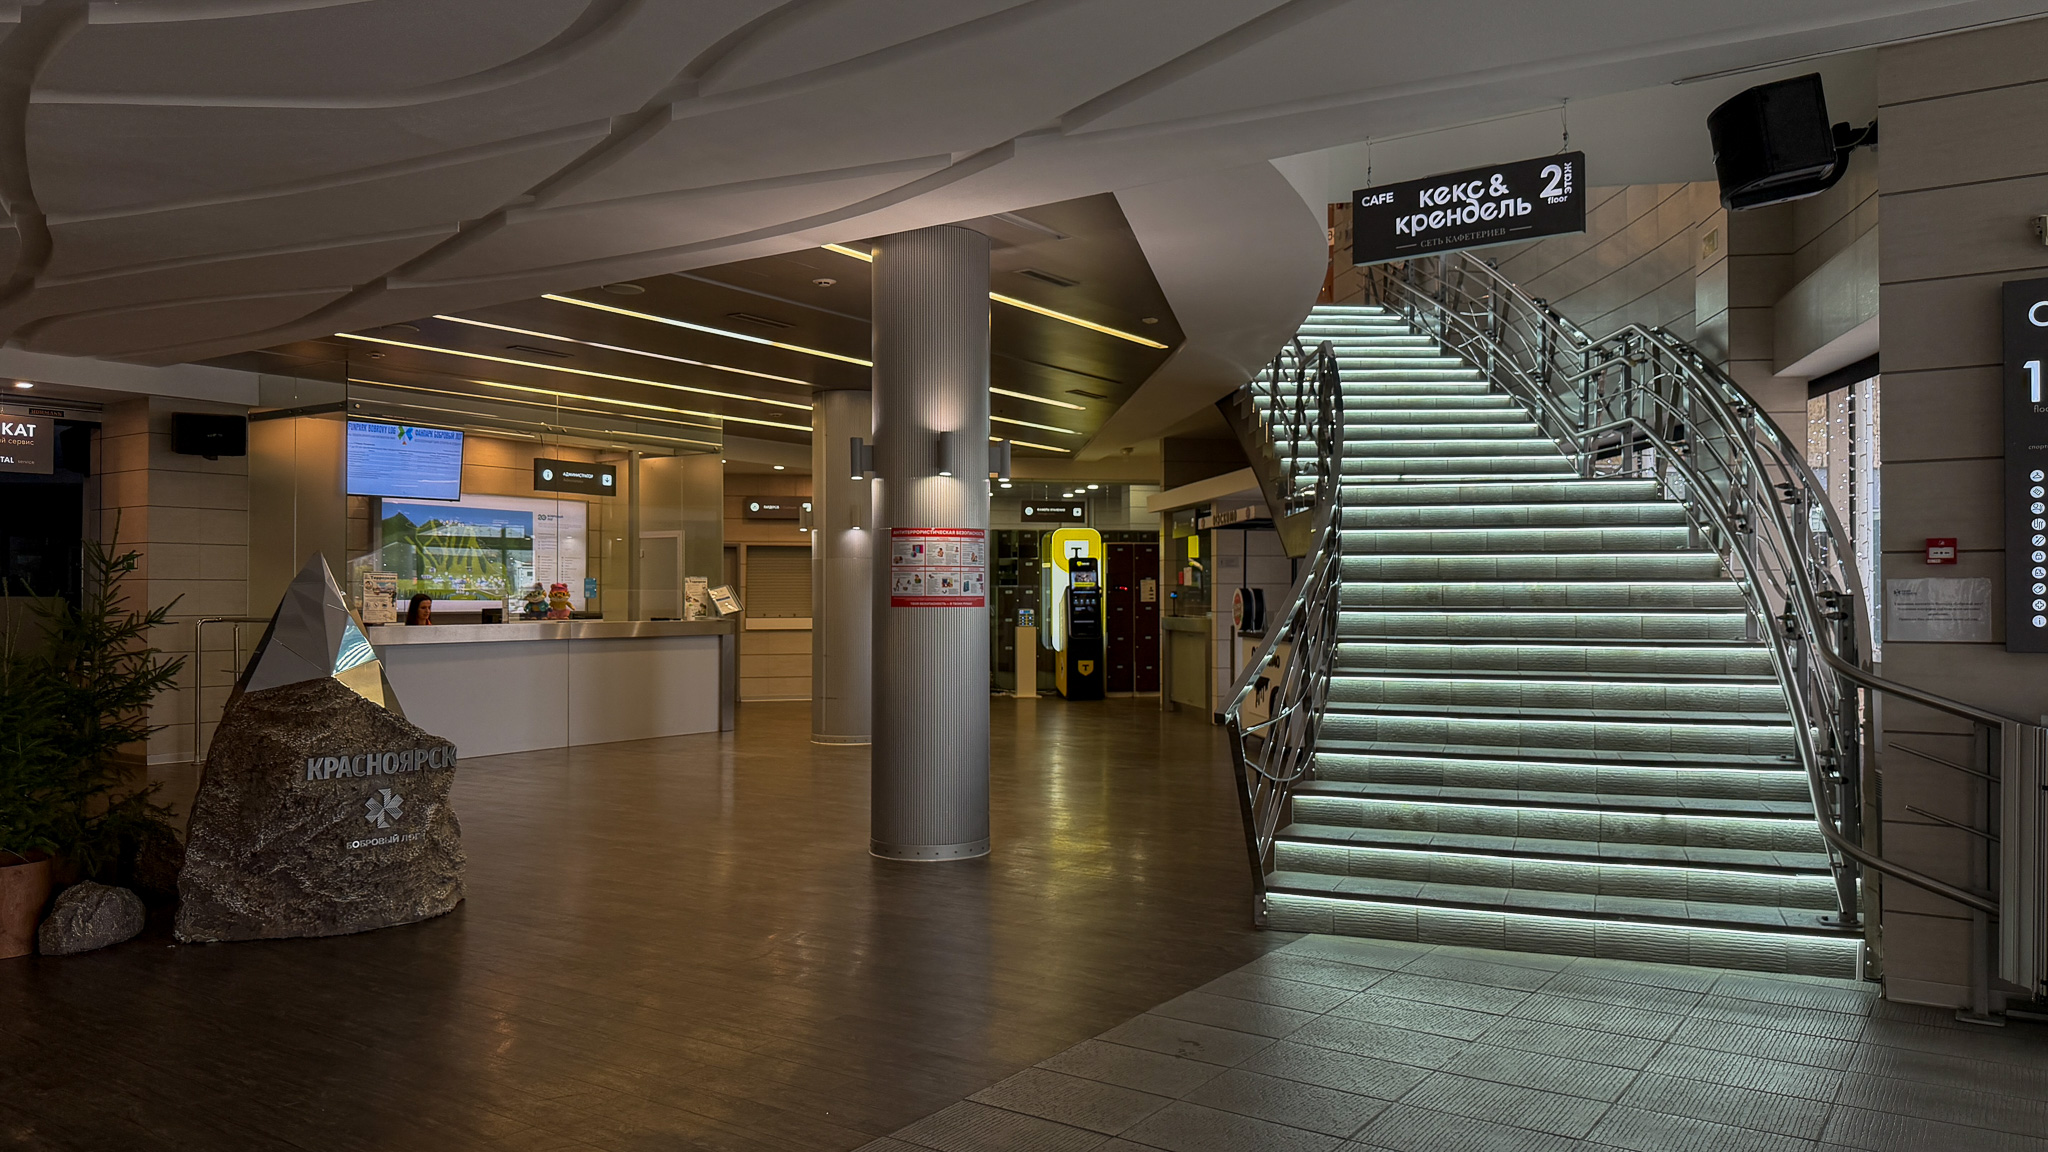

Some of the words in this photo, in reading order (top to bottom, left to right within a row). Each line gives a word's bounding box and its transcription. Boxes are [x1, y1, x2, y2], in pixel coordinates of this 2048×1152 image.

[1489, 173, 1510, 198] &
[1539, 164, 1563, 199] 2
[1563, 161, 1573, 194] этаж
[1361, 192, 1394, 207] CAFE
[1547, 195, 1568, 205] floor
[1420, 236, 1444, 248] СЕТЬ
[1445, 227, 1506, 245] КАФЕТЕРИЕВ
[2023, 360, 2041, 403] 1
[1, 422, 37, 437] КАТ
[307, 745, 457, 780] КРАСНОЯРСК
[347, 834, 399, 850] БОБРОВЫЙ
